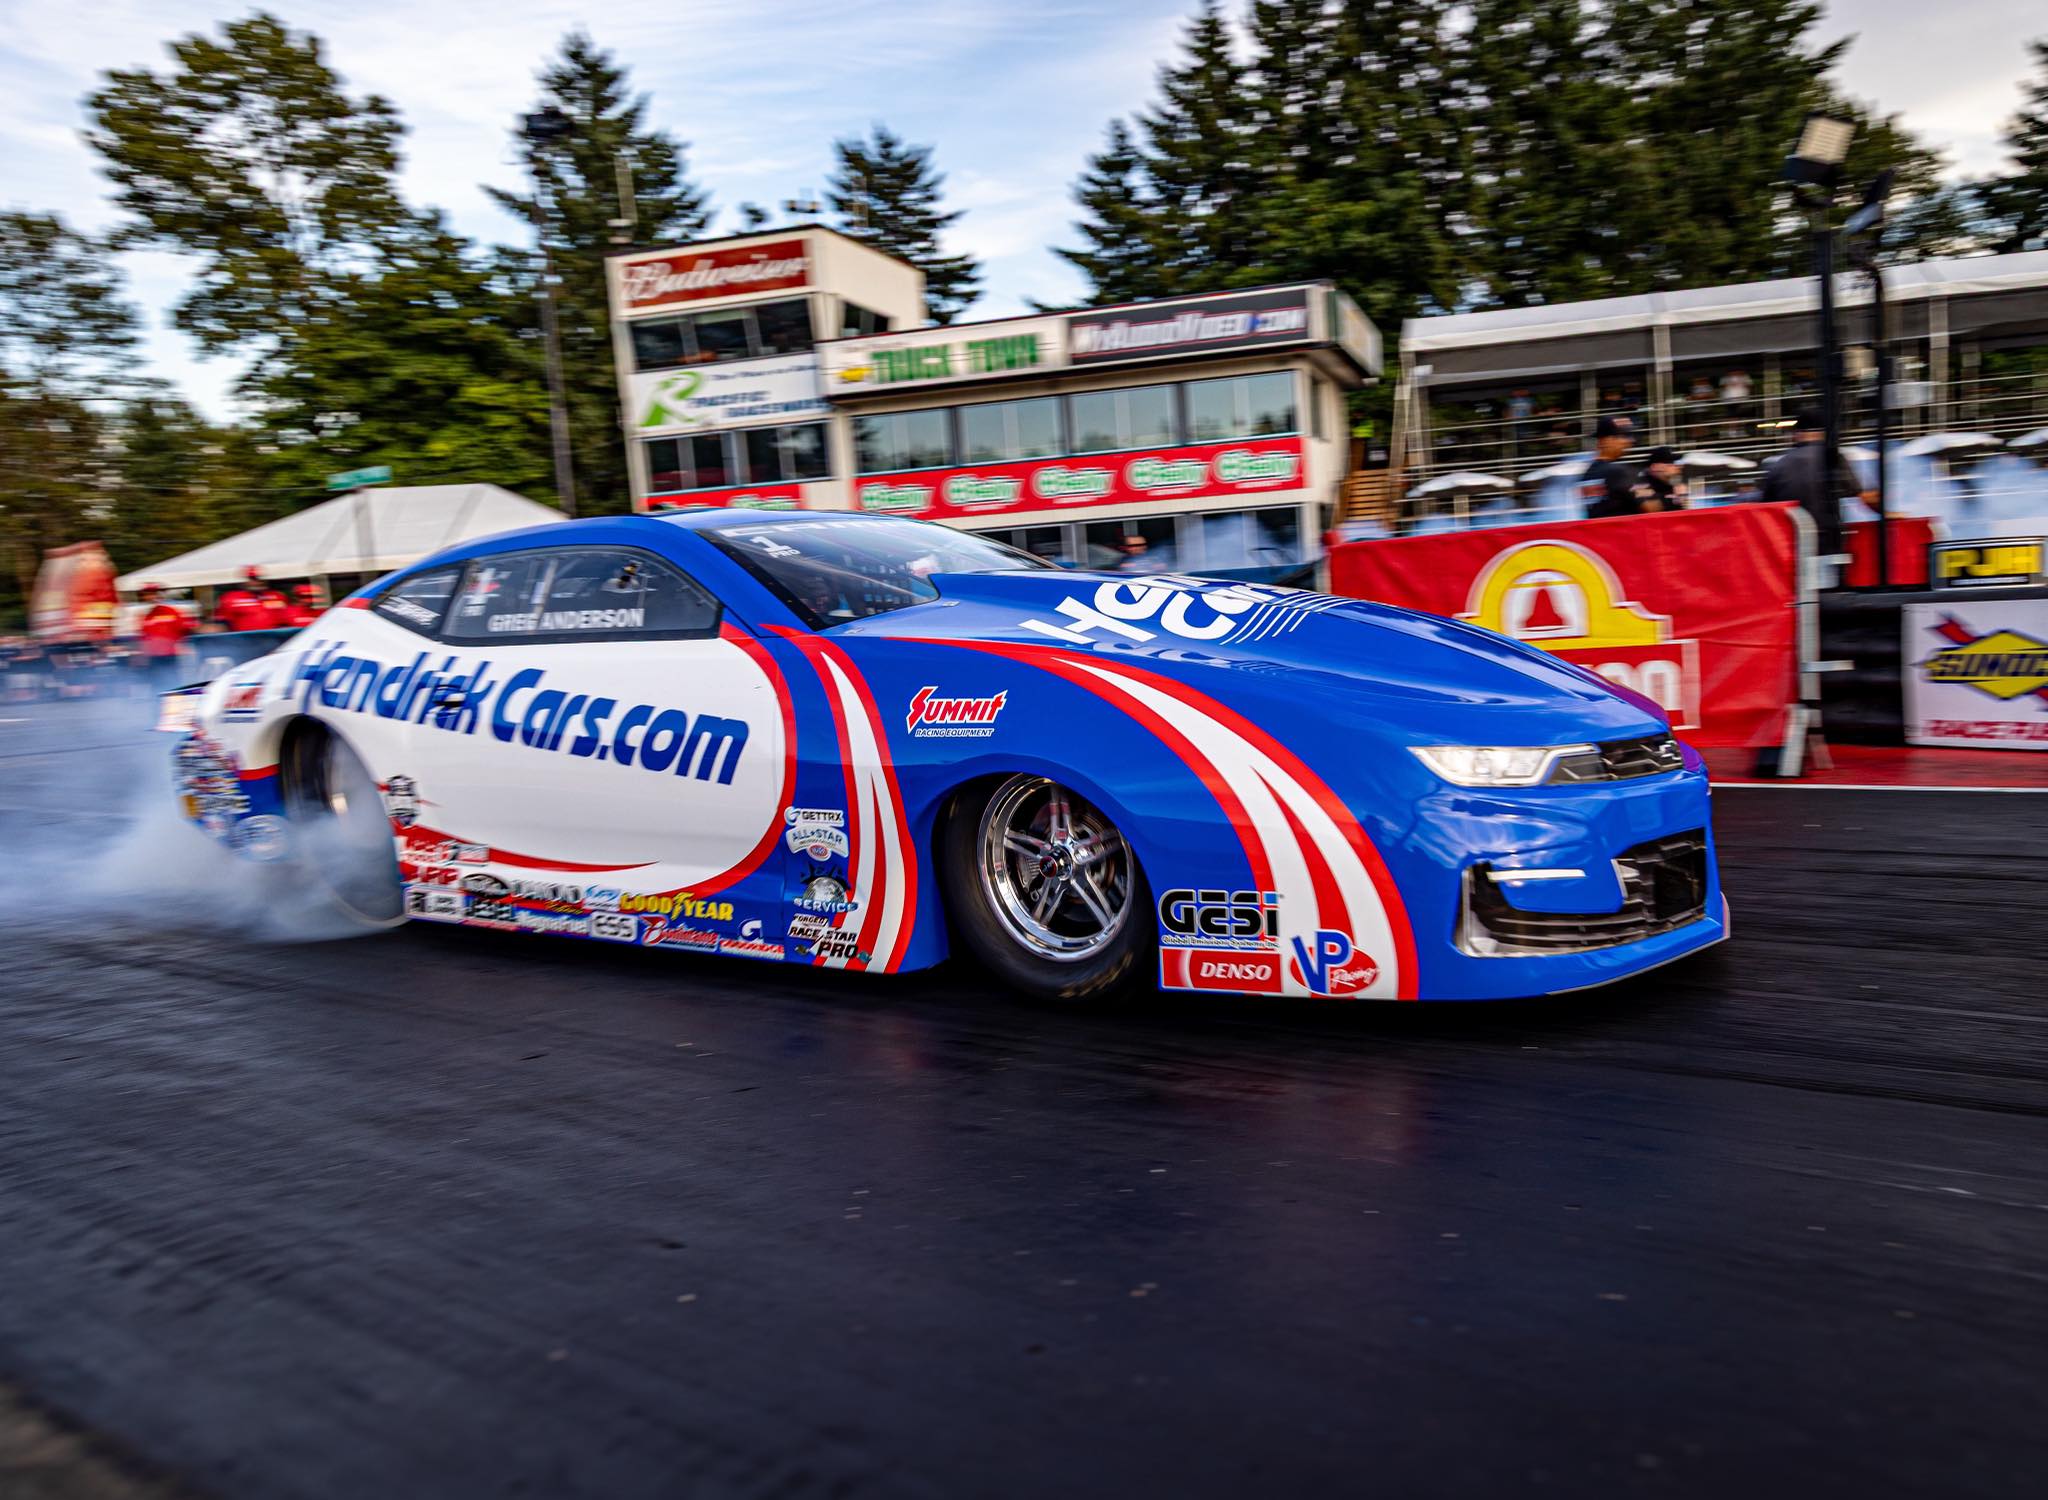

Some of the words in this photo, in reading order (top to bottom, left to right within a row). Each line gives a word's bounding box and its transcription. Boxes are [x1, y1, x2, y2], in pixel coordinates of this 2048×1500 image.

[488, 614, 538, 632] GREG
[540, 608, 645, 631] ANDERSON
[906, 686, 1008, 734] SUMMIT
[915, 728, 945, 737] RACING
[946, 728, 994, 737] EQUIPMENT
[802, 811, 842, 821] GETTRX
[620, 892, 734, 921] GOODYEAR
[789, 926, 820, 939] RACE
[826, 929, 857, 942] STAR
[818, 941, 858, 958] PRO
[1200, 962, 1273, 981] DENSO
